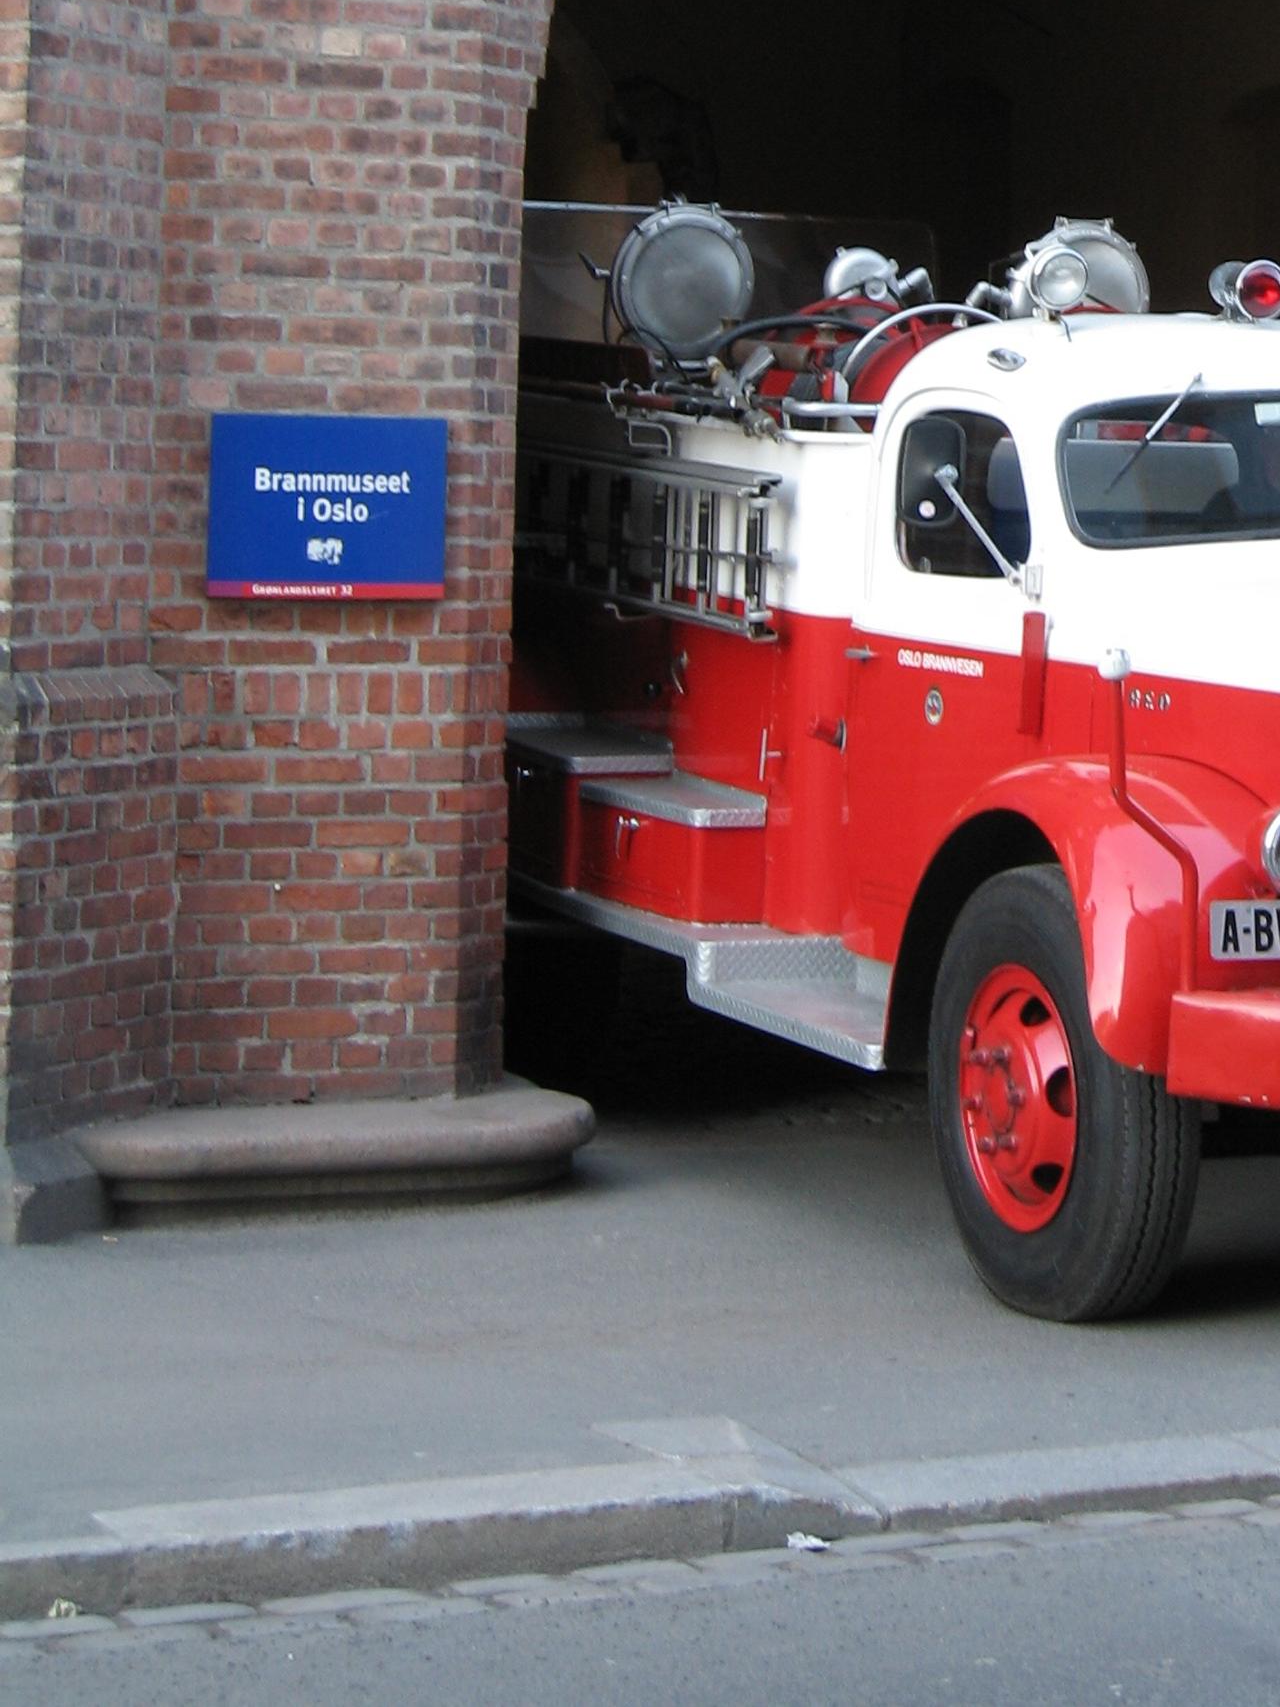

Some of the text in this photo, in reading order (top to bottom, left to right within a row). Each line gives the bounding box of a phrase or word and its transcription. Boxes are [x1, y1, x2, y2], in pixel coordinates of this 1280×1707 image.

[255, 467, 411, 494] Brannmuseet
[297, 497, 370, 523] i Oslo
[897, 648, 984, 678] OSLO BRANNVESEN
